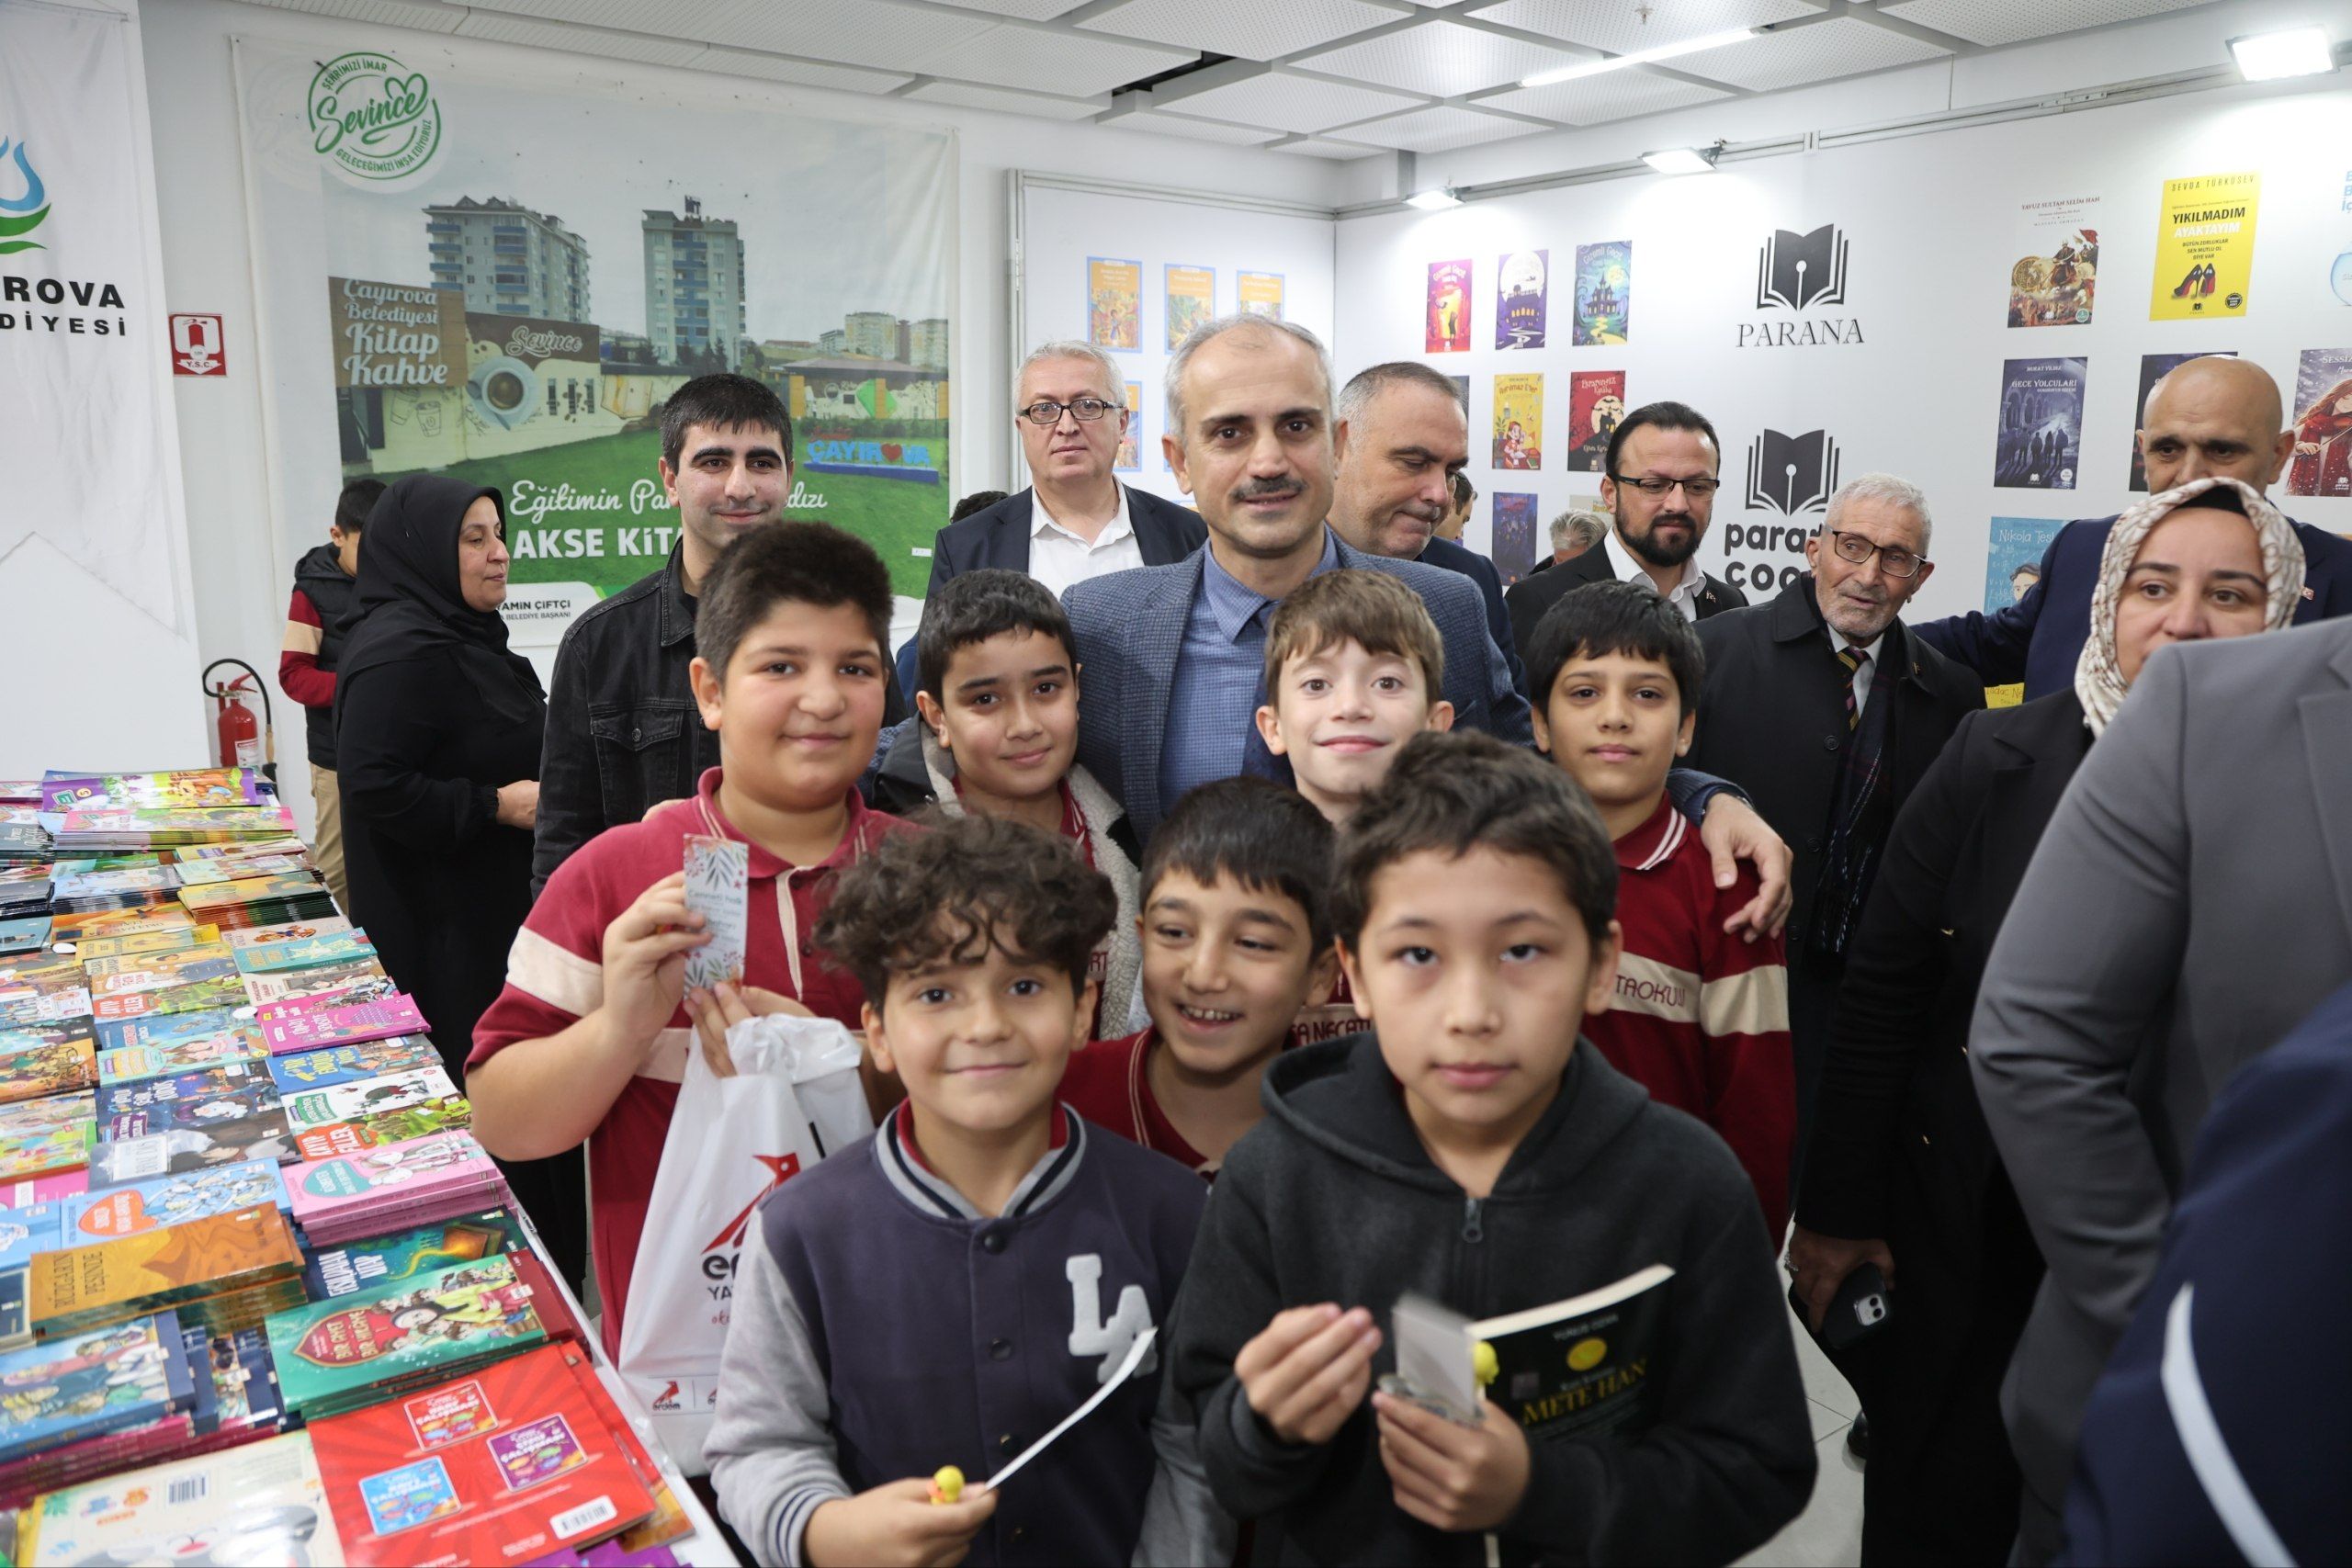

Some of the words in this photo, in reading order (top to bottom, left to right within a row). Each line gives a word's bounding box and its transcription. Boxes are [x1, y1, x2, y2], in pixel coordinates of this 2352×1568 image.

[362, 58, 388, 73] İMAR
[315, 90, 420, 154] Sevince
[335, 148, 395, 173] GELECEĞİMİZİ
[2173, 207, 2245, 224] YIKILMADIM
[2174, 222, 2241, 239] AYAKTAYIM
[4, 276, 125, 309] ROVA
[343, 278, 438, 305] Çayırova
[344, 301, 439, 327] Belediyesi
[344, 321, 441, 362] Kitap
[506, 325, 583, 358] Sevince
[1736, 319, 1865, 348] PARANA
[344, 354, 449, 386] Kahve
[2011, 379, 2032, 388] GECE
[2033, 378, 2077, 388] YOLCULARI
[510, 479, 623, 525] Eğitimin
[629, 479, 673, 515] Pa
[513, 528, 605, 560] AKSE
[1999, 529, 2032, 544] Nikola
[506, 613, 547, 621] BELEDİYE
[548, 611, 571, 620] BAŞKANI
[535, 599, 571, 612] ÇİFTÇİ
[301, 1134, 336, 1157] KAYIP
[330, 1125, 361, 1154] FİLLER
[1066, 1253, 1159, 1383] LA
[1522, 1386, 1592, 1426] METE
[1597, 1357, 1648, 1399] HAN
